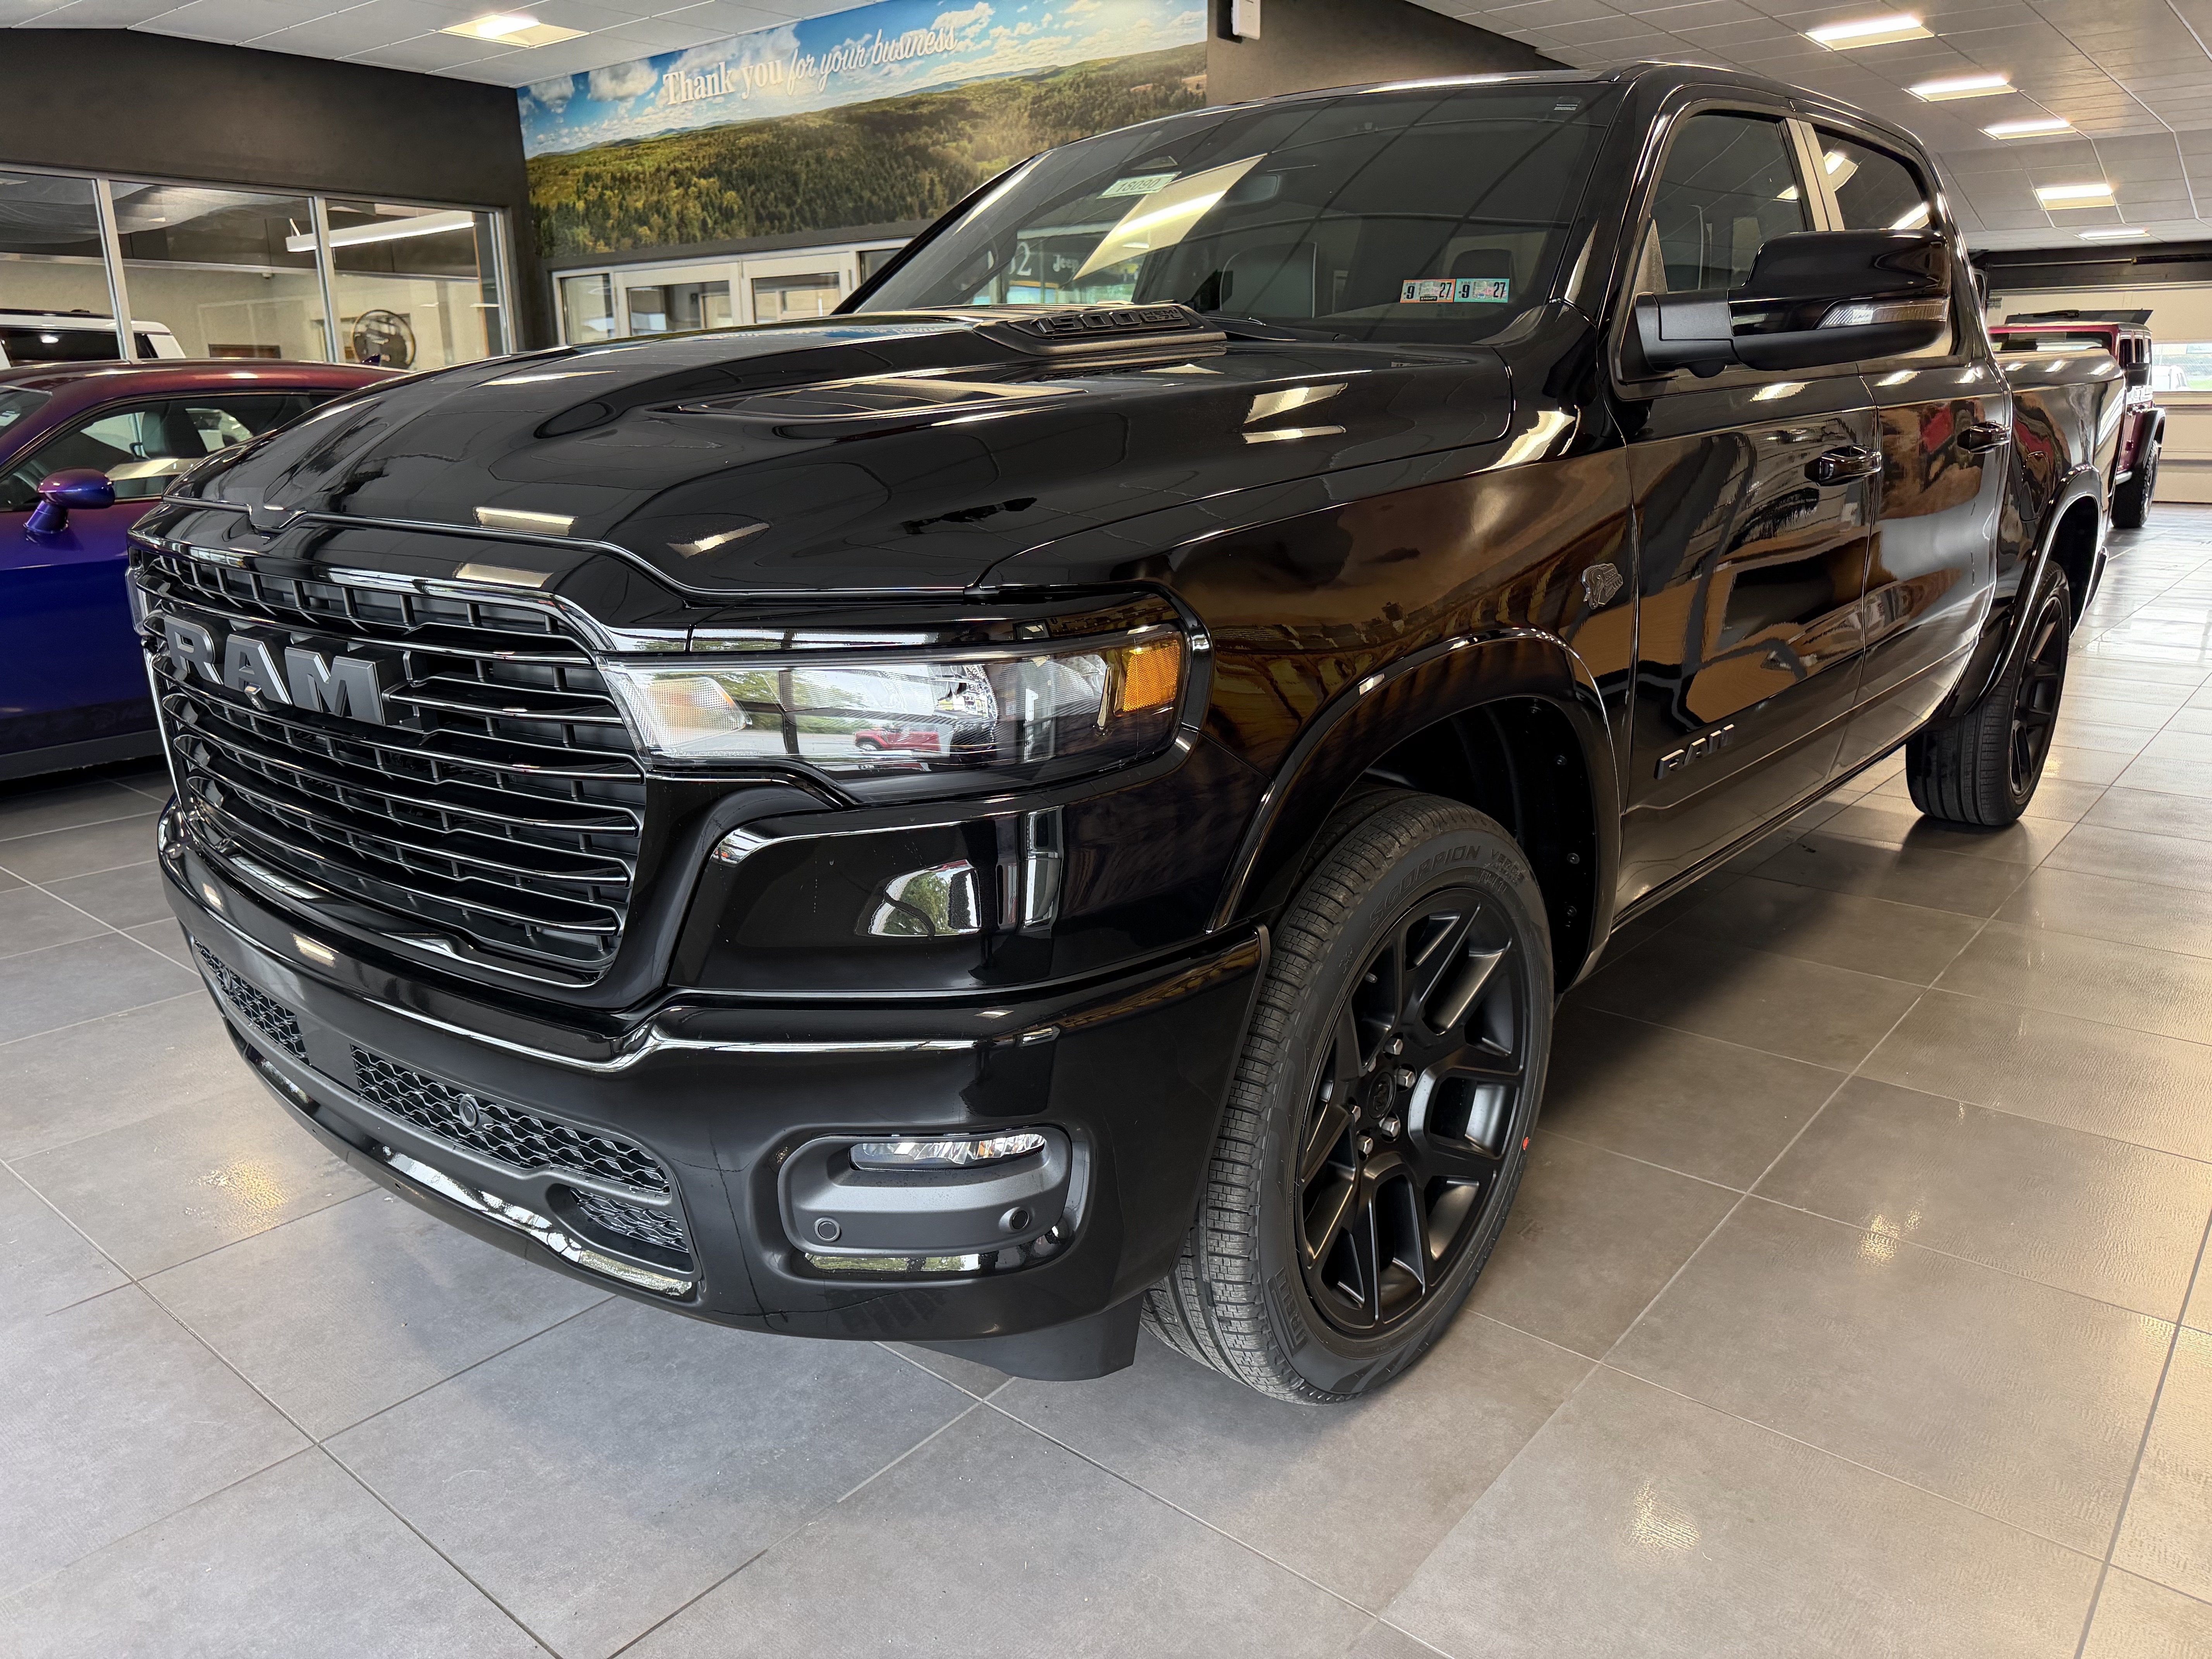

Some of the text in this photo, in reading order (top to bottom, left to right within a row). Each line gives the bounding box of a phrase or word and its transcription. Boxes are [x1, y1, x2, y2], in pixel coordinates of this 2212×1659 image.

[663, 28, 958, 105] Thank you for your business
[1406, 282, 1452, 299] 9 27
[1461, 282, 1506, 298] 9 27
[1032, 310, 1142, 334] 1500
[164, 614, 386, 726] RAM
[1654, 724, 1735, 780] RAM
[1370, 845, 1480, 929] SCORPION
